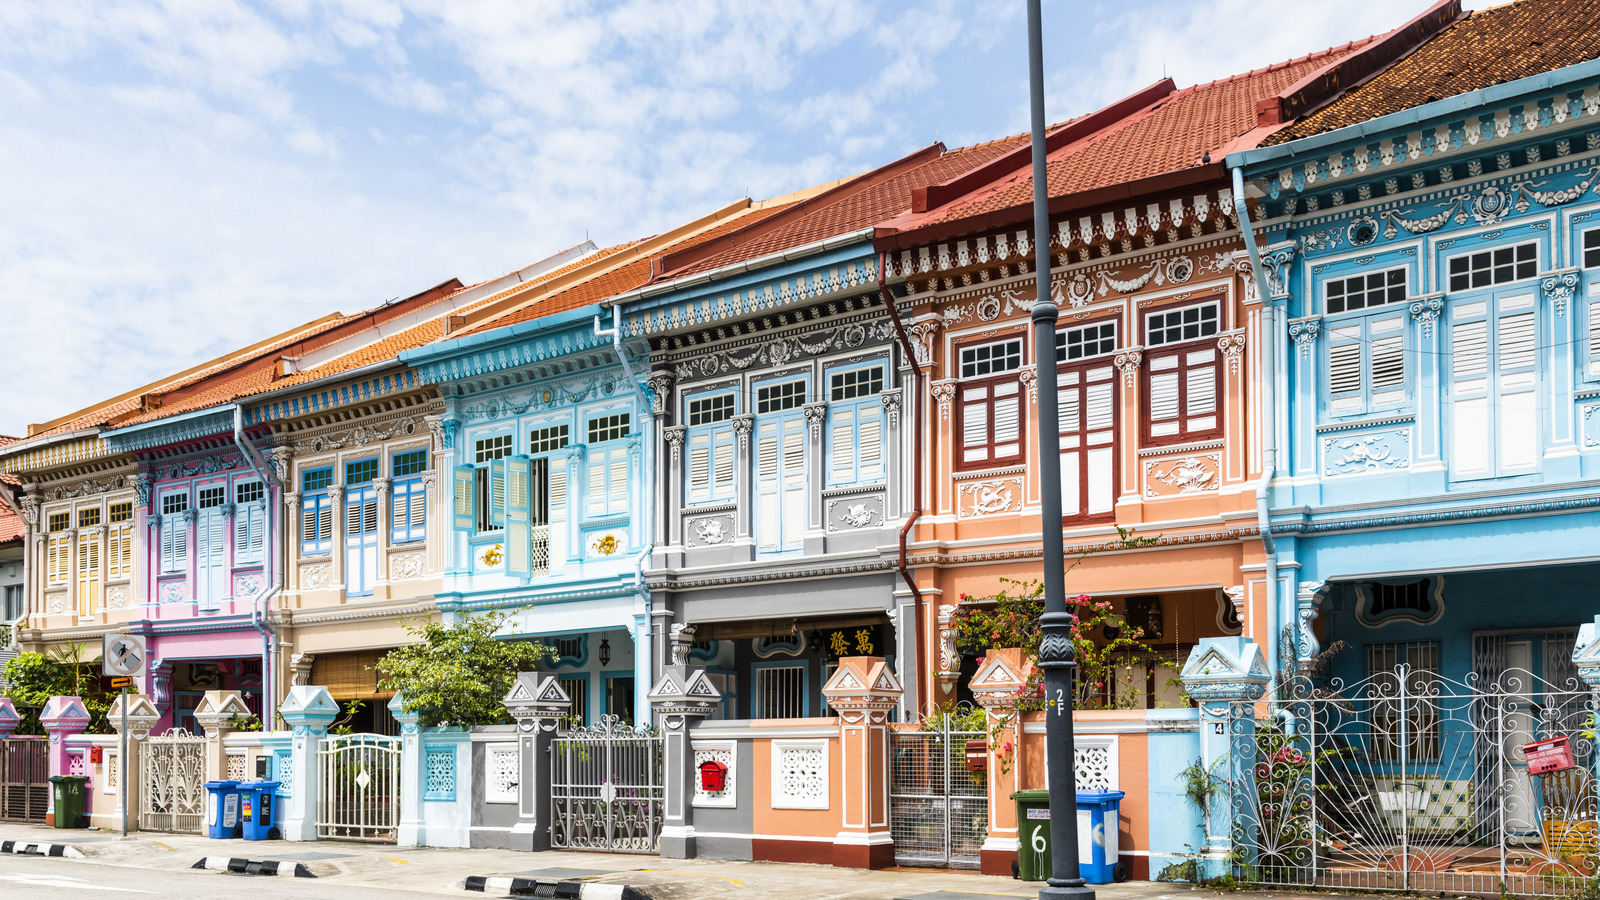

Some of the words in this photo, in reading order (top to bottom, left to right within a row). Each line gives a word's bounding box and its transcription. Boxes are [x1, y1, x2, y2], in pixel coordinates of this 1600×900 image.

[1215, 723, 1224, 734] 4
[1031, 824, 1047, 853] 6
[1092, 822, 1106, 847] 6
